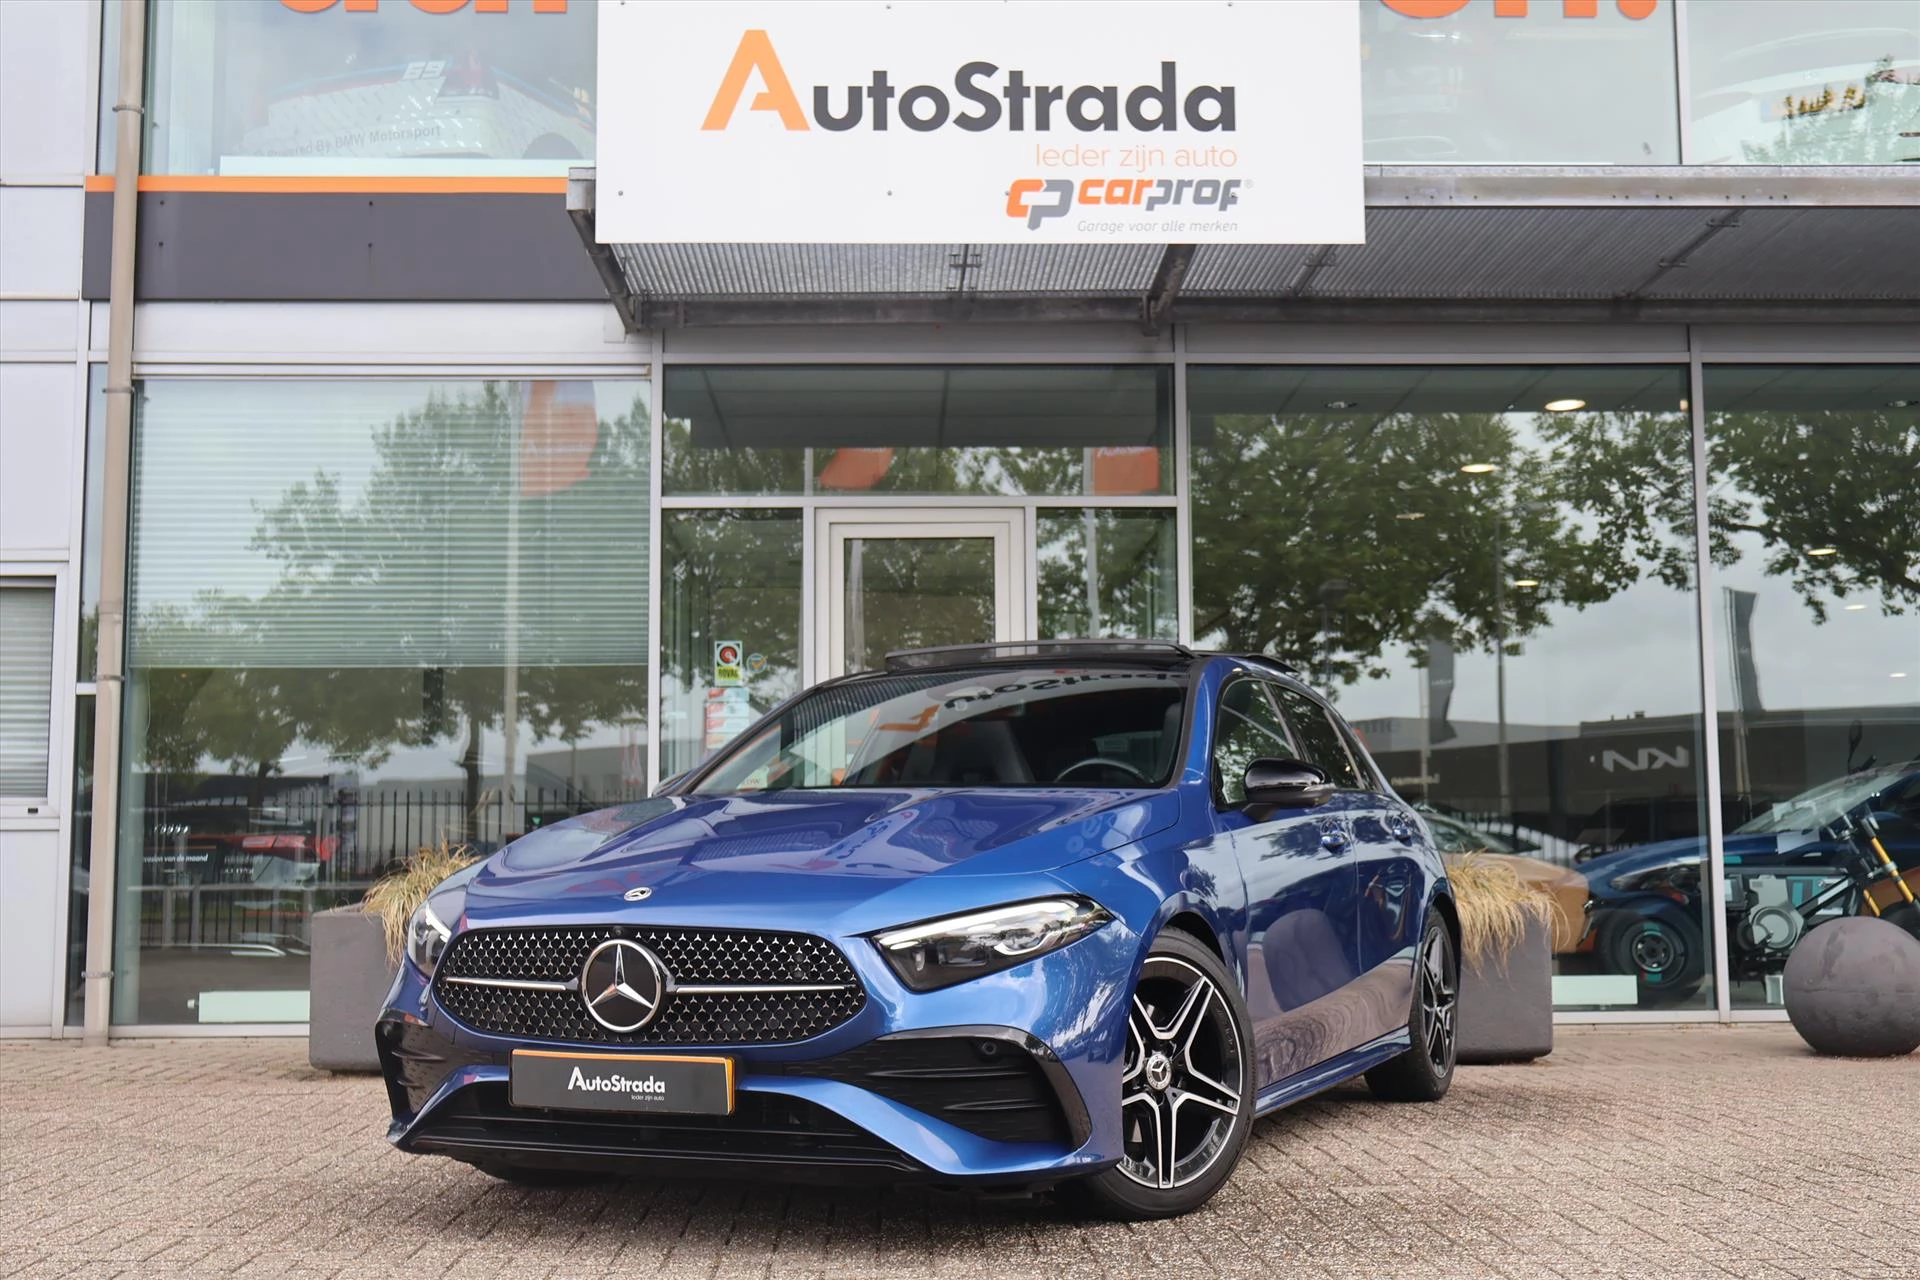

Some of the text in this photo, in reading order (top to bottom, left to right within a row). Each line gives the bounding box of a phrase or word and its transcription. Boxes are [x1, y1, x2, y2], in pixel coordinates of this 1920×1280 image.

[402, 61, 445, 80] 69
[701, 29, 1236, 132] AutoStrada
[334, 132, 366, 149] BMW
[370, 124, 441, 144] Motorsport
[1036, 144, 1238, 173] Ieder zijn auto
[1077, 220, 1238, 235] Garage voor alle merken
[567, 1066, 666, 1093] AutoStrada
